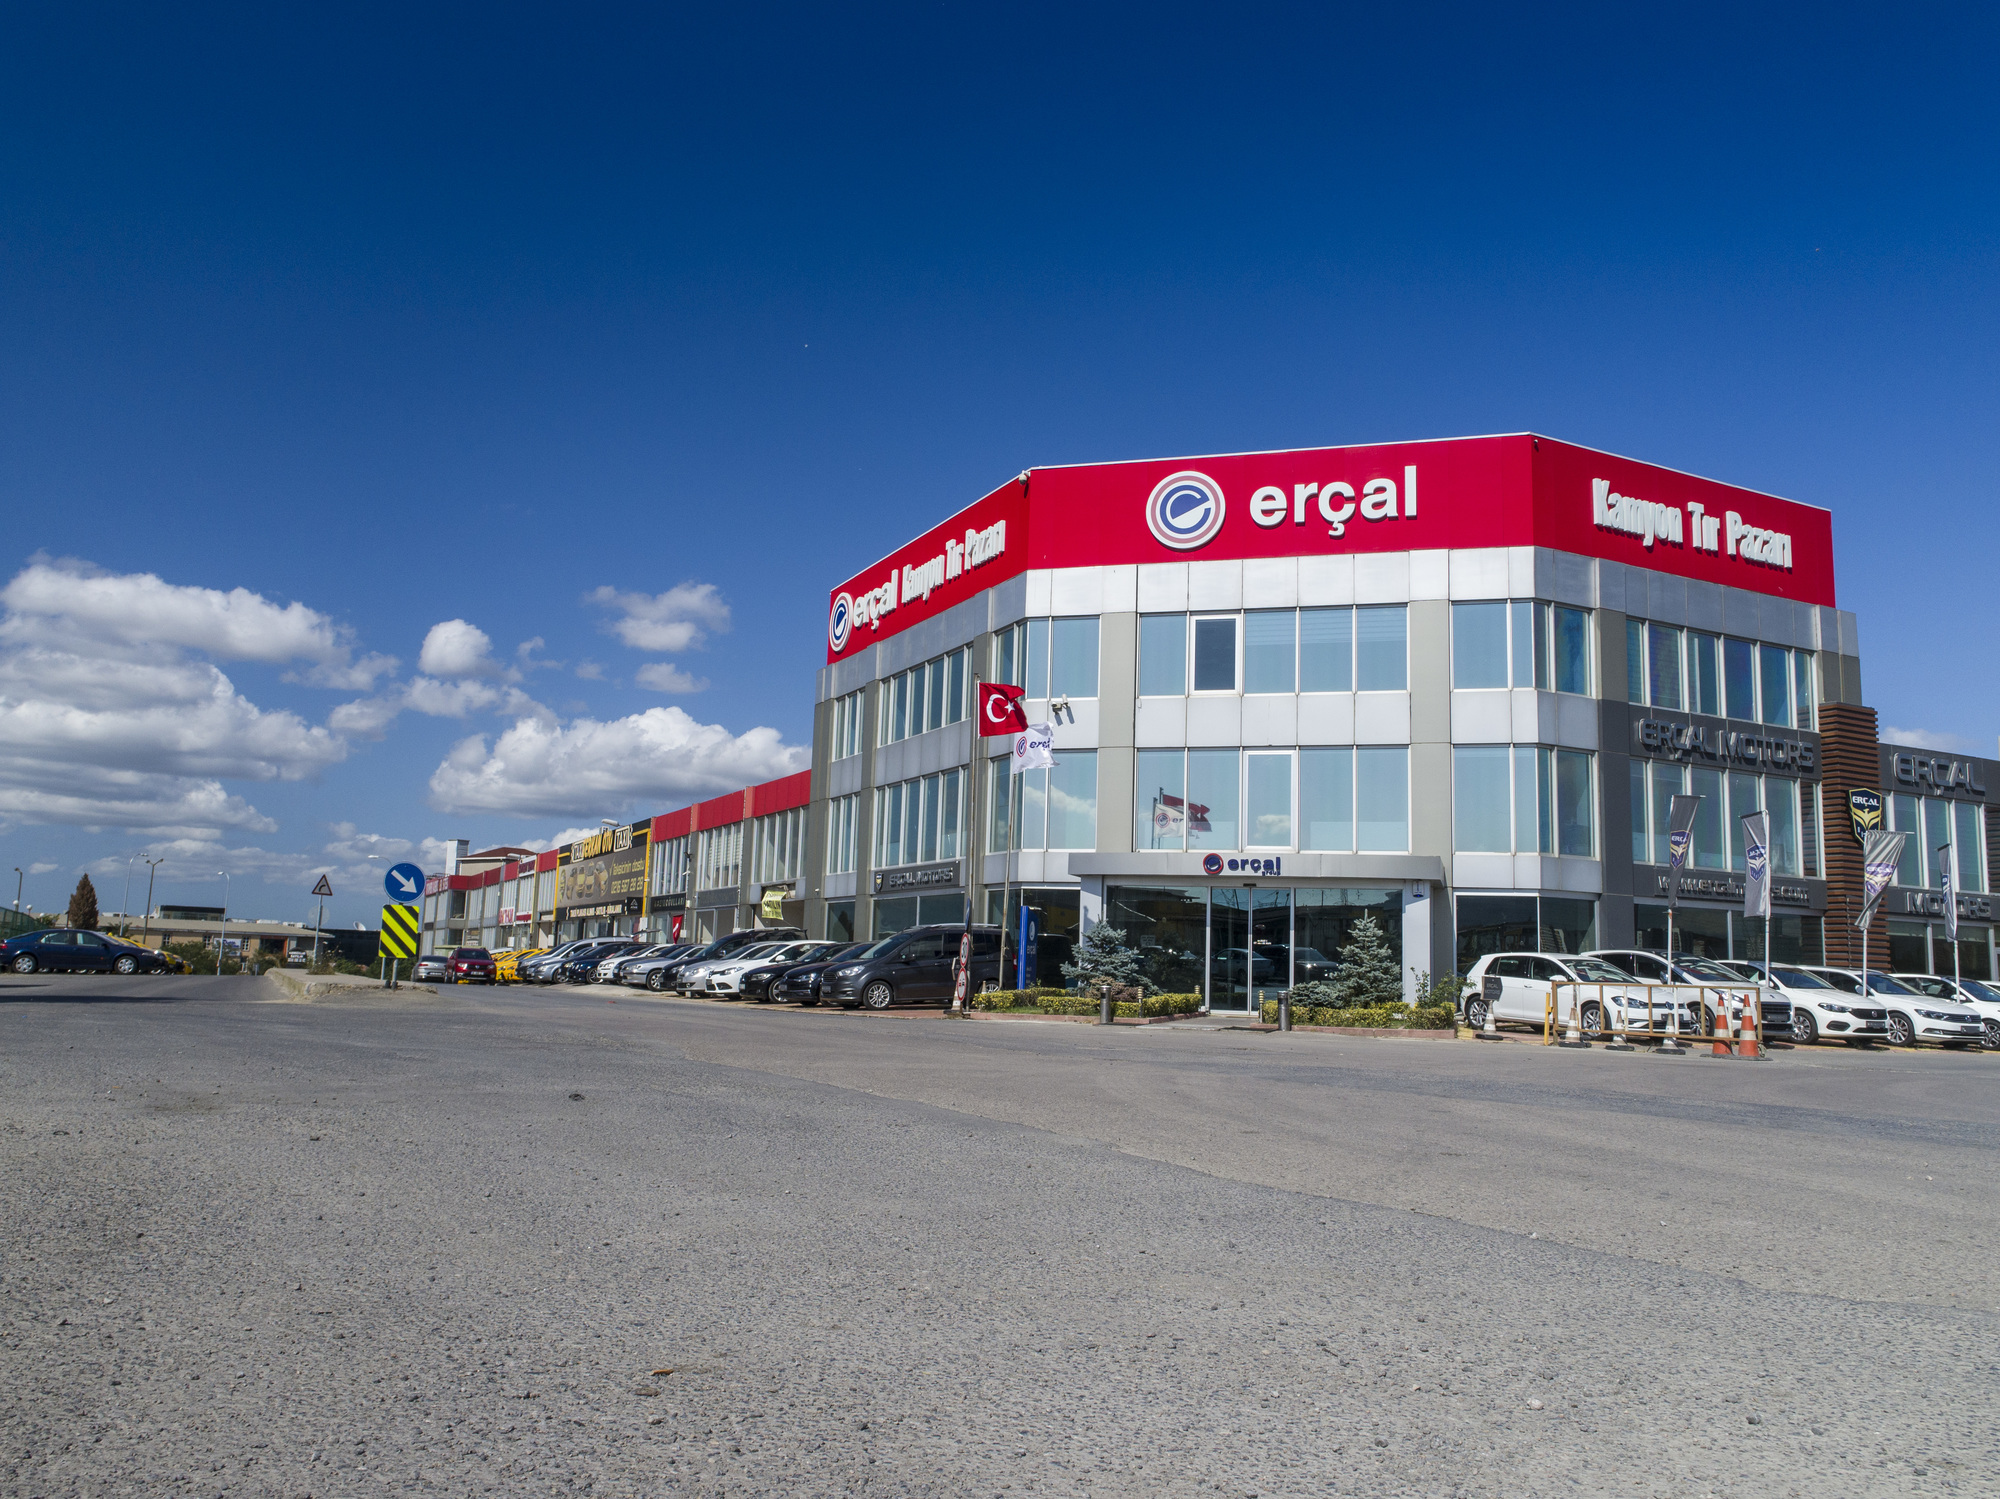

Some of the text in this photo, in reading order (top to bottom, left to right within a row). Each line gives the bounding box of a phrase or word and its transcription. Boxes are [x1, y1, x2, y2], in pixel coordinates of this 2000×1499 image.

[1250, 465, 1417, 536] erçal
[1592, 478, 1792, 568] Kamyon Tır Pazarı
[853, 520, 1006, 630] erçal Kamyon Tır Pazarı
[1718, 730, 1814, 767] MOTORS
[616, 829, 629, 849] TAXI
[916, 867, 953, 883] MOTORS
[1228, 857, 1281, 873] erçal
